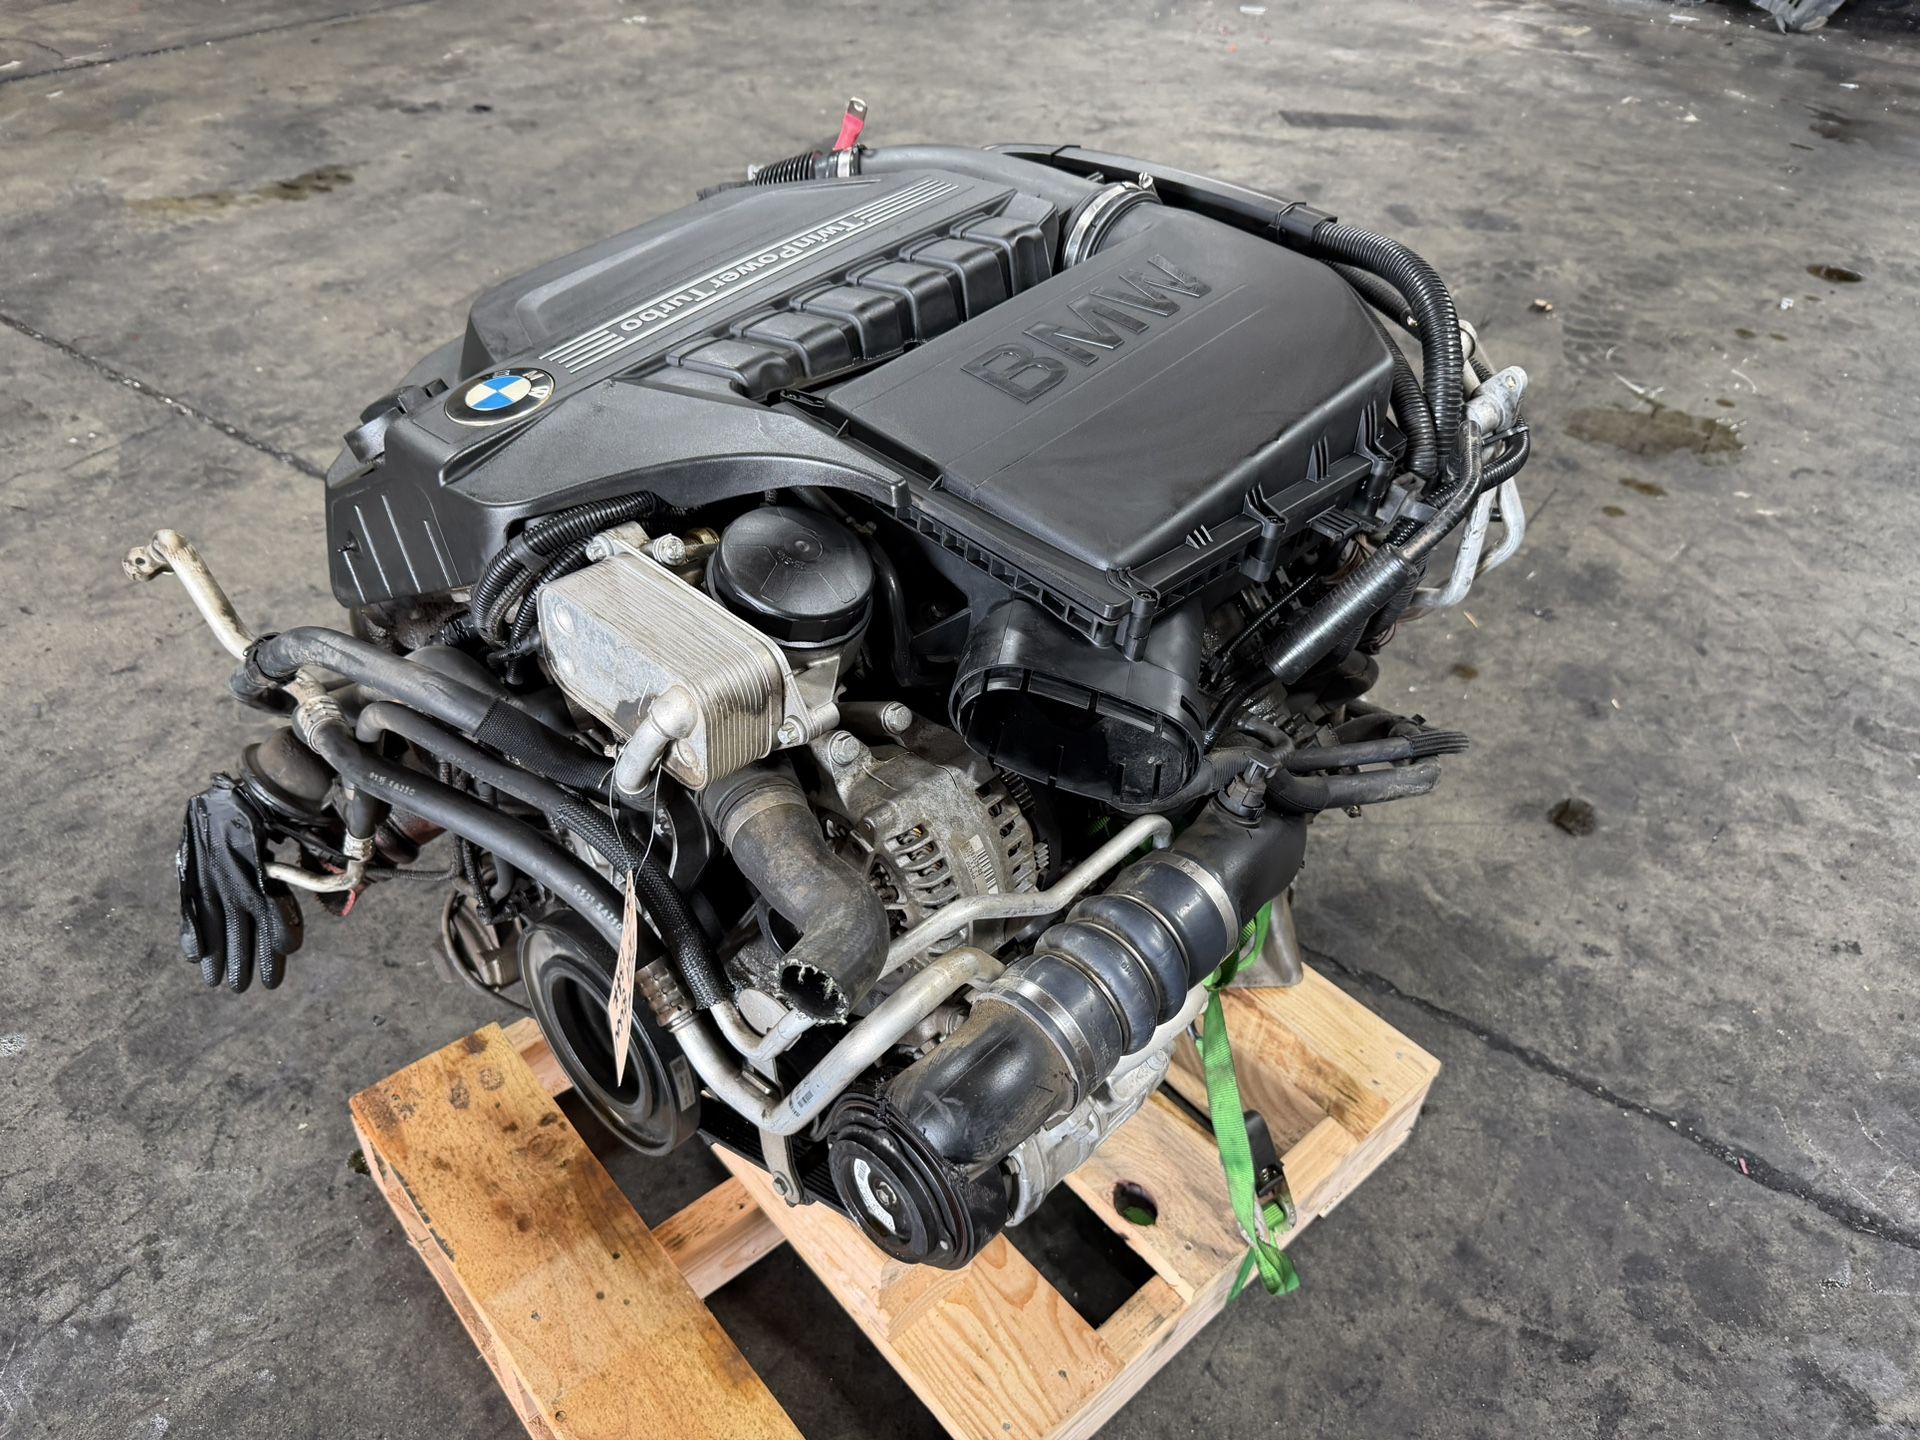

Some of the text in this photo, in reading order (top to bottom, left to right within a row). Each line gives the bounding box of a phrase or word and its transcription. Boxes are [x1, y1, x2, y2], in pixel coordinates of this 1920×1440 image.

[619, 216, 865, 332] TwinPower Turbo
[960, 254, 1212, 404] BMW
[493, 369, 550, 400] BMW
